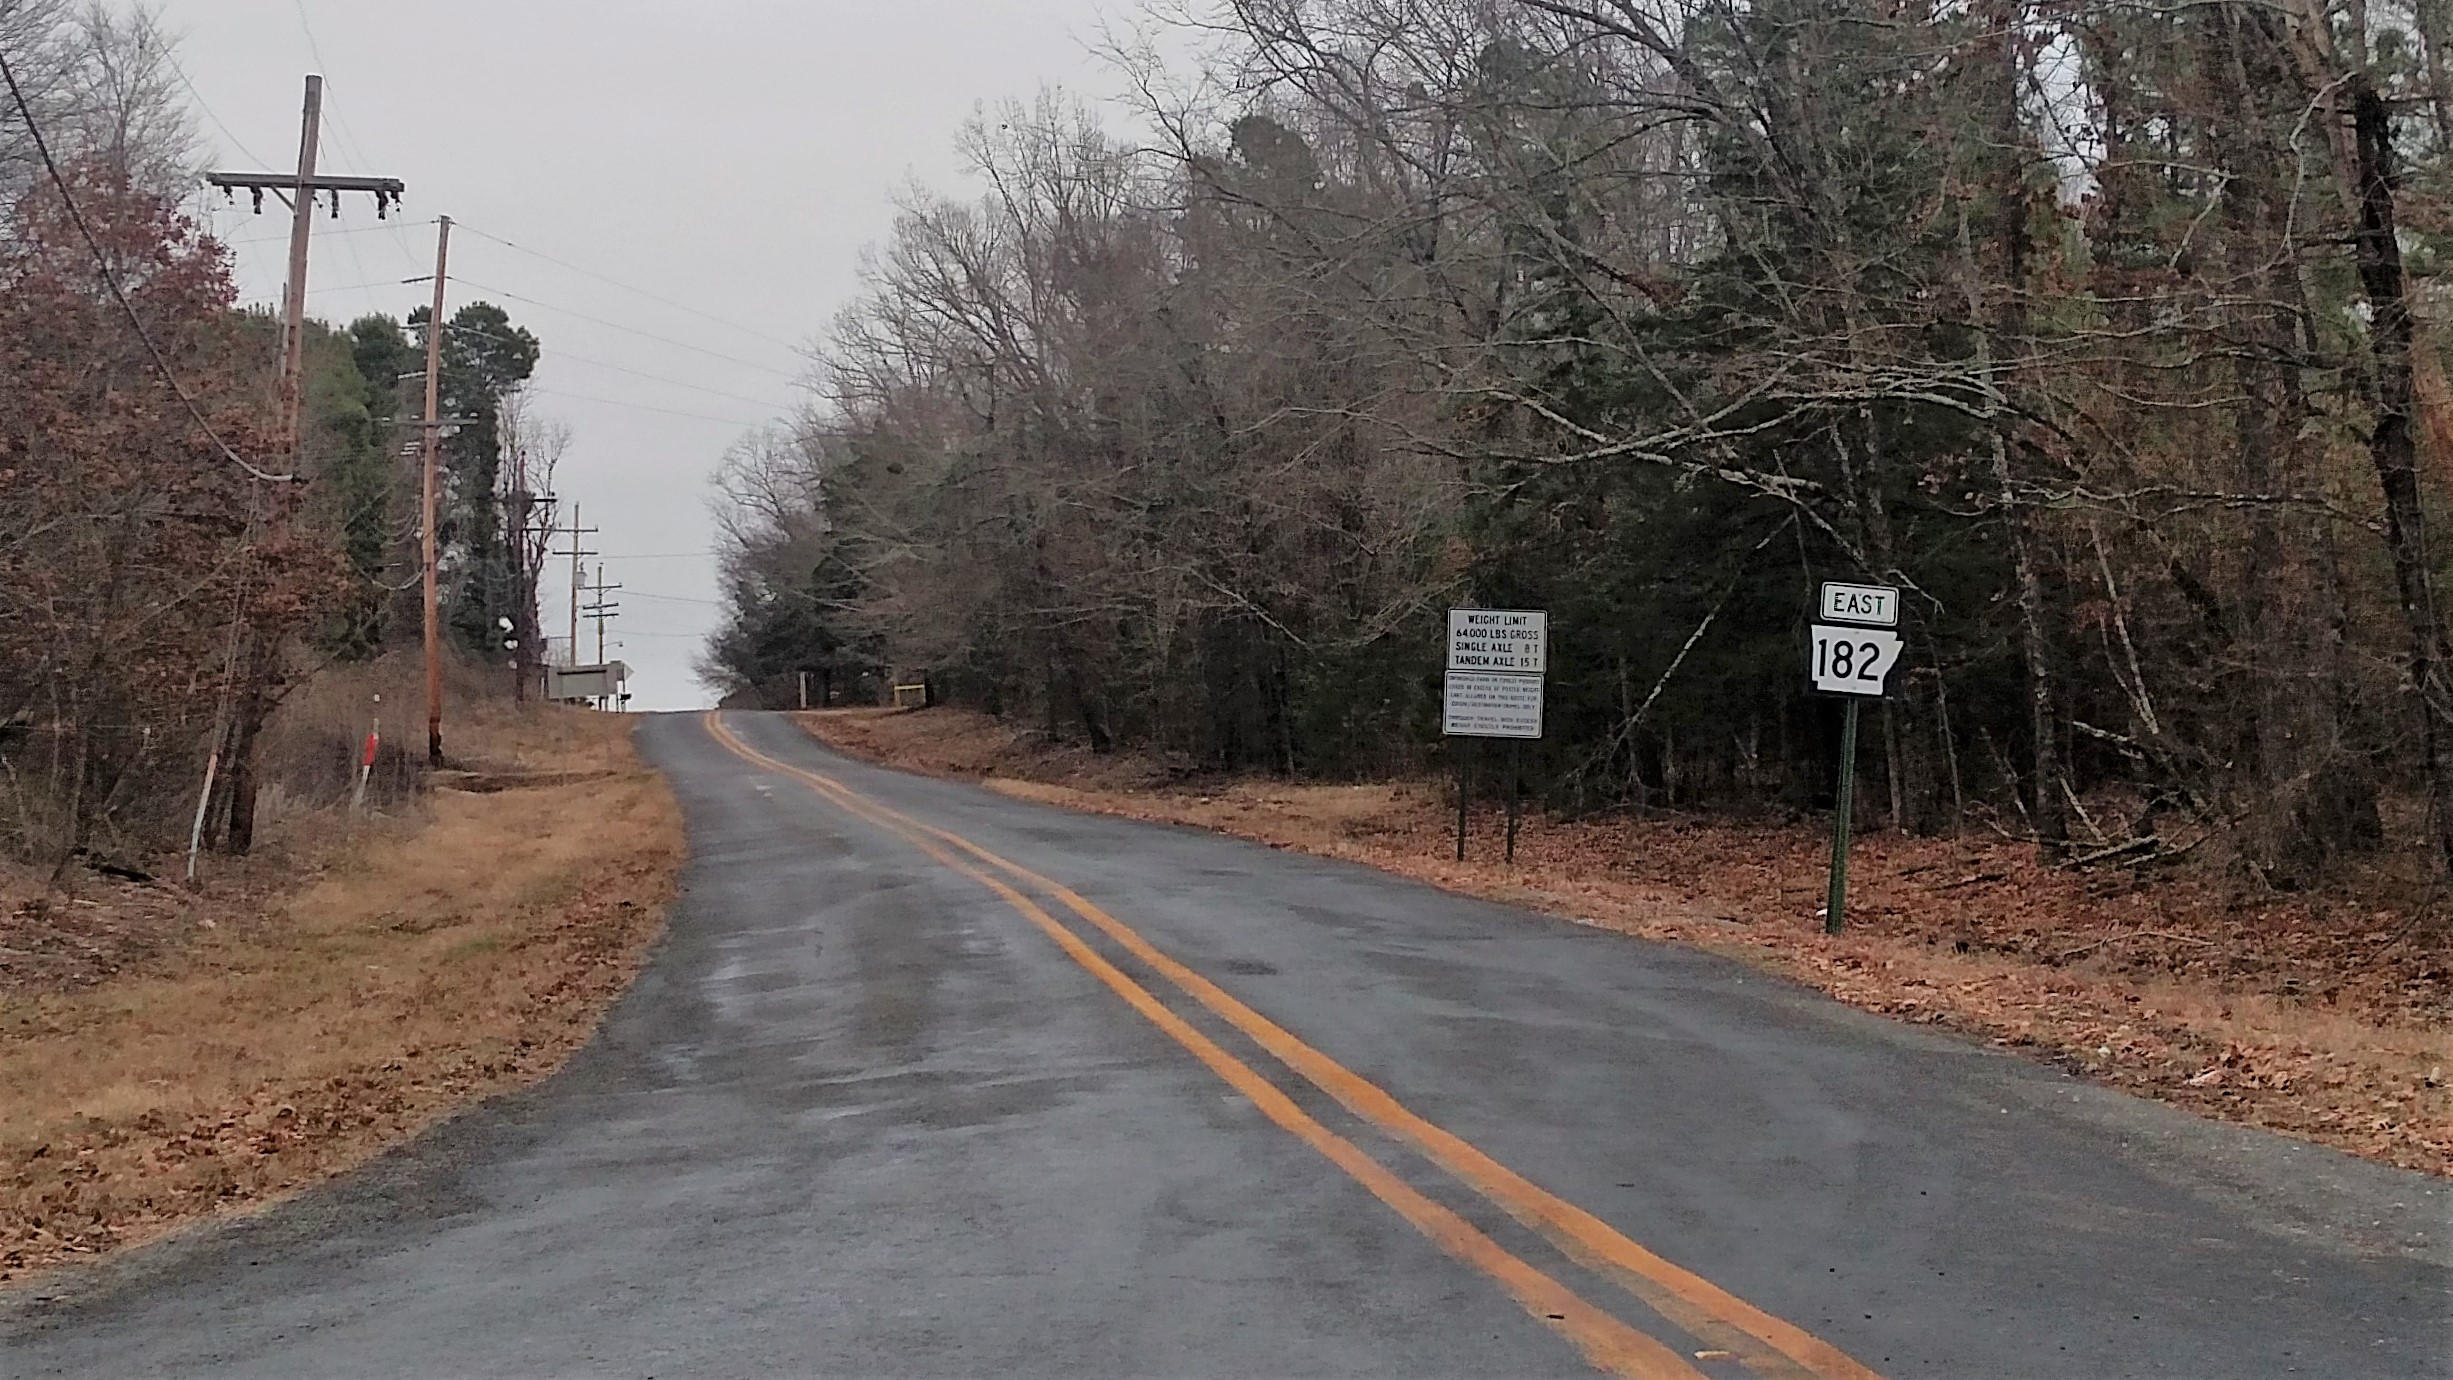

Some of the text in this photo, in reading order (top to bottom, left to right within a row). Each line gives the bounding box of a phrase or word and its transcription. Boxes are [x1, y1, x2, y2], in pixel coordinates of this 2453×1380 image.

[1834, 592, 1885, 615] EAST
[1468, 615, 1527, 626] WEIGHT LIMIT
[1490, 630, 1507, 639] LBS
[1510, 631, 1538, 640] GROSS
[1456, 642, 1486, 652] SINGLE
[1492, 643, 1513, 653] AXLE
[1534, 645, 1538, 653] T
[1455, 656, 1538, 667] TANDEM AXLE 15 T
[1819, 639, 1880, 681] 182
